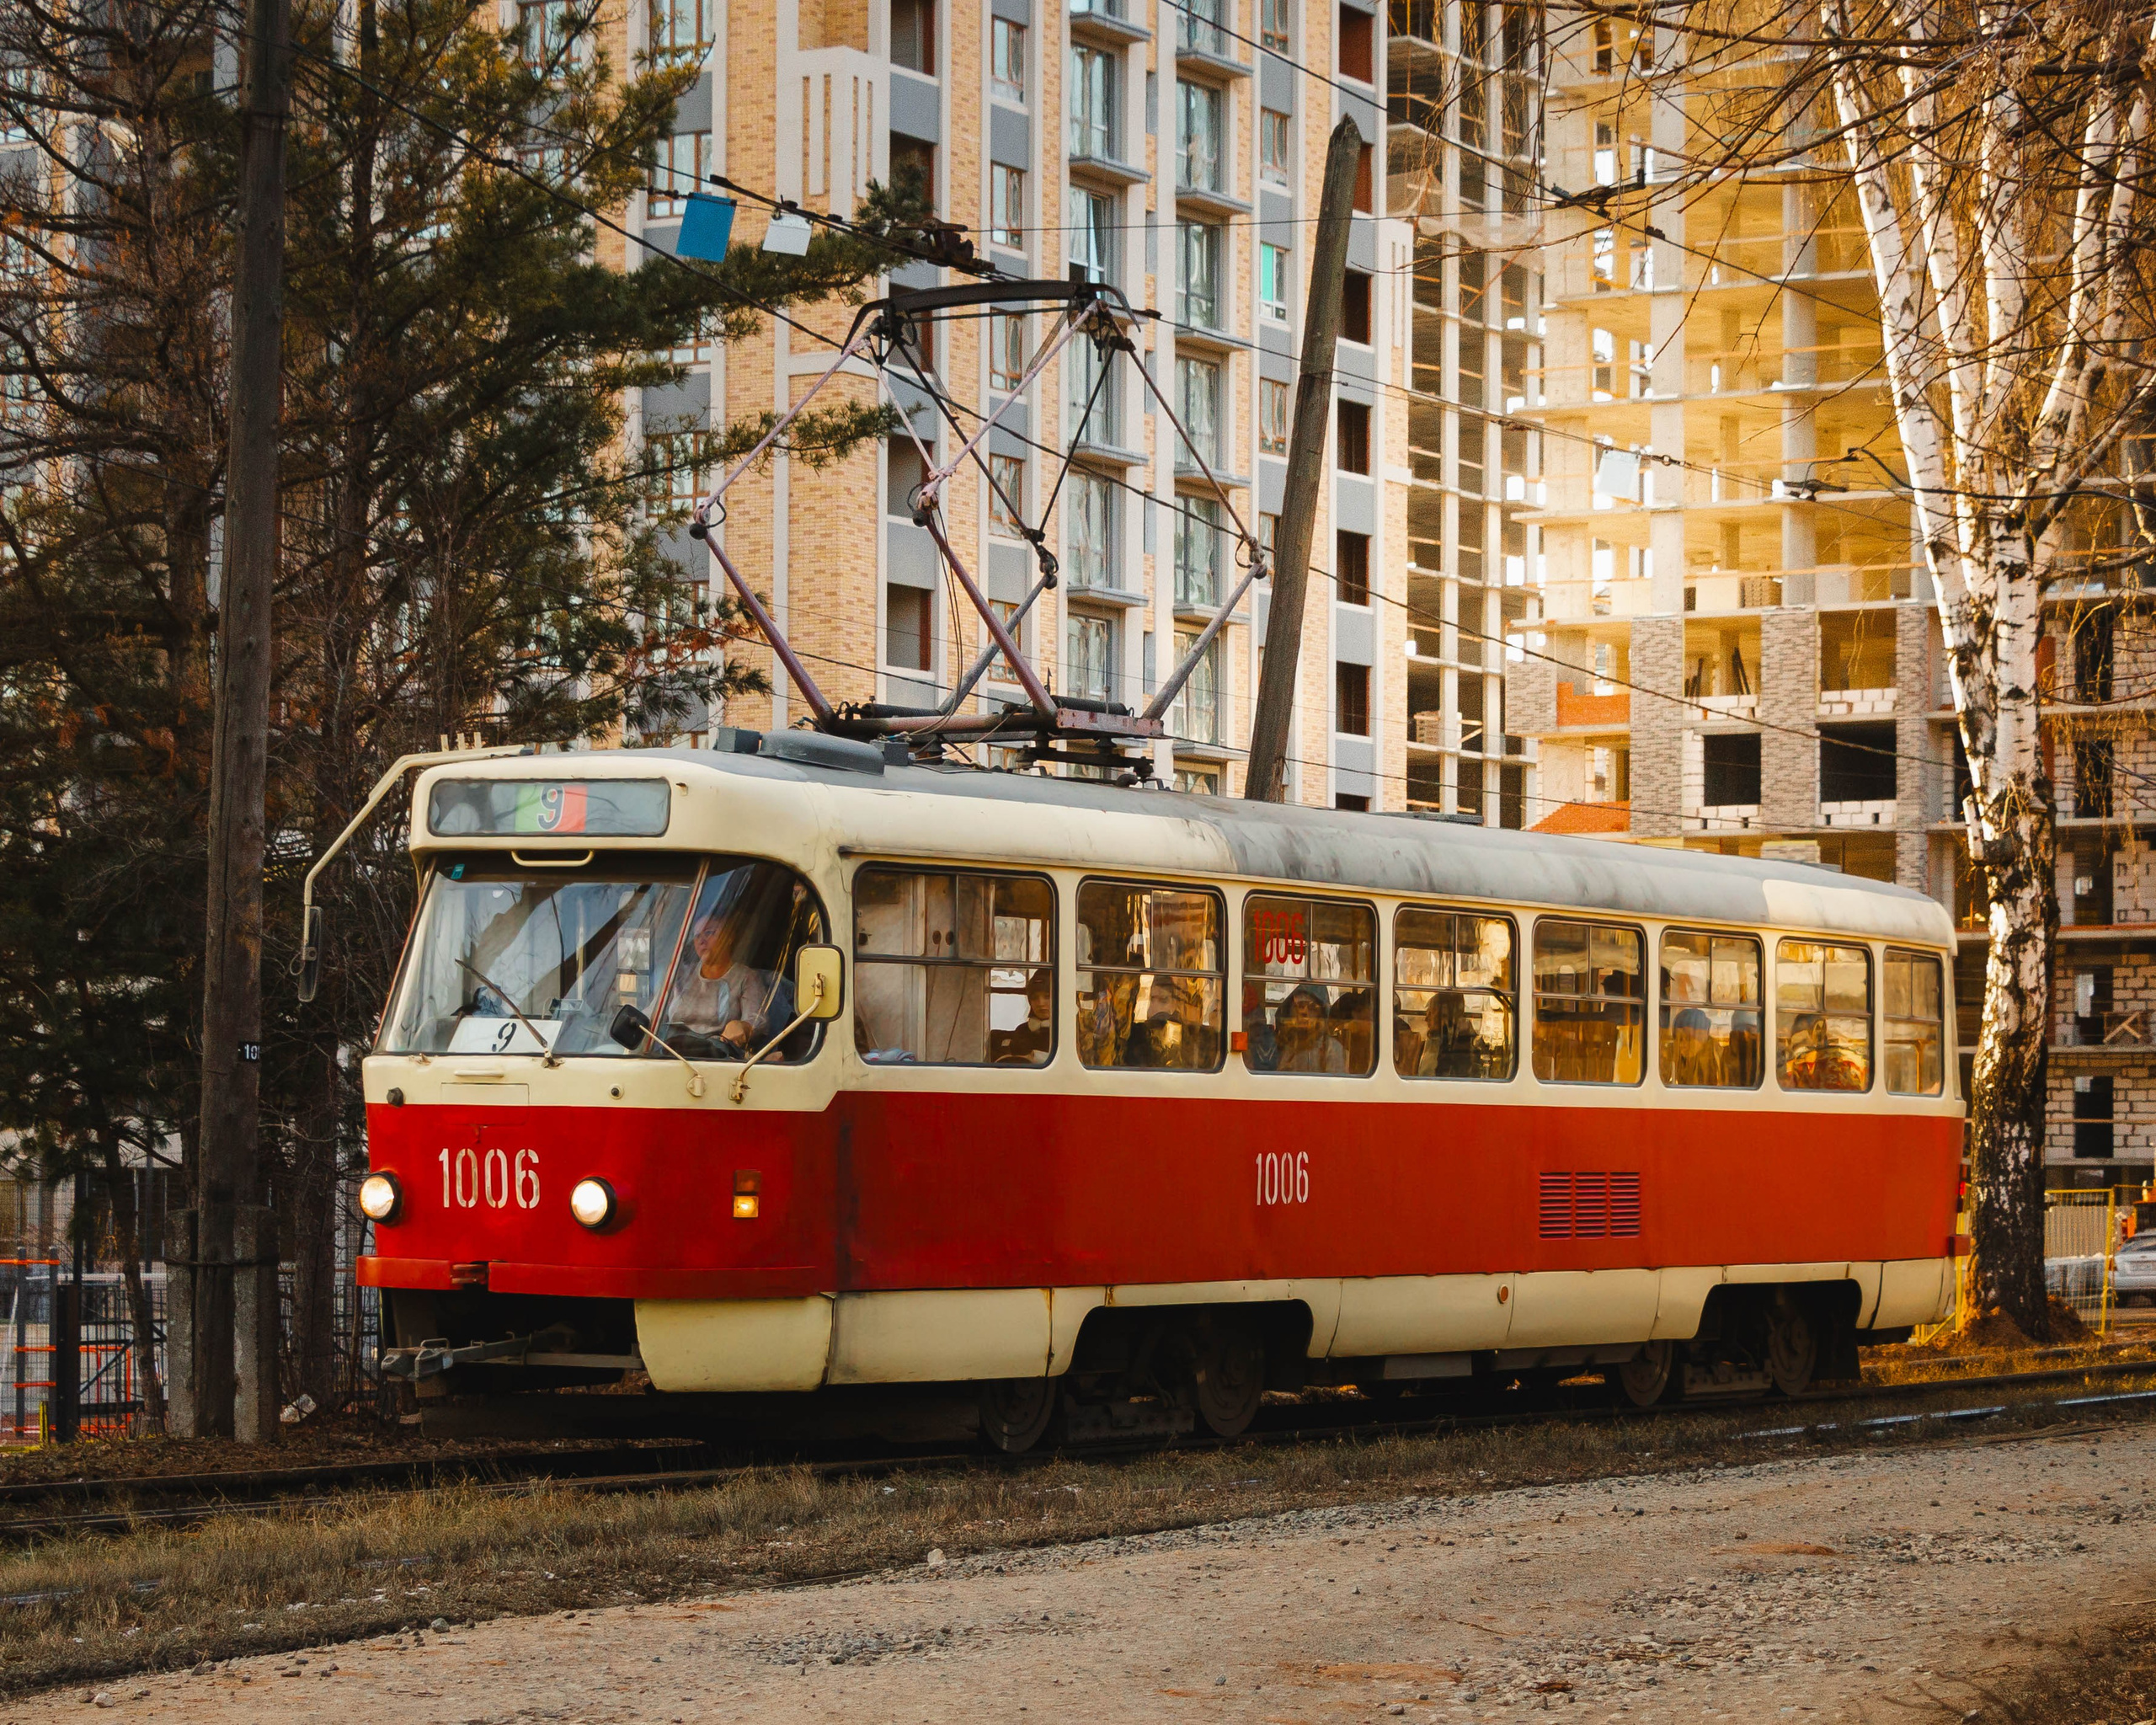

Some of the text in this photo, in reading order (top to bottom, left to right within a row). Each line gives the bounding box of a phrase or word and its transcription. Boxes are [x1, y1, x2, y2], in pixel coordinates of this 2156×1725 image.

[537, 785, 565, 830] 9
[1253, 909, 1305, 964] 1006
[491, 1022, 517, 1053] 9
[438, 1148, 540, 1209] 1006
[1255, 1151, 1309, 1205] 1006
